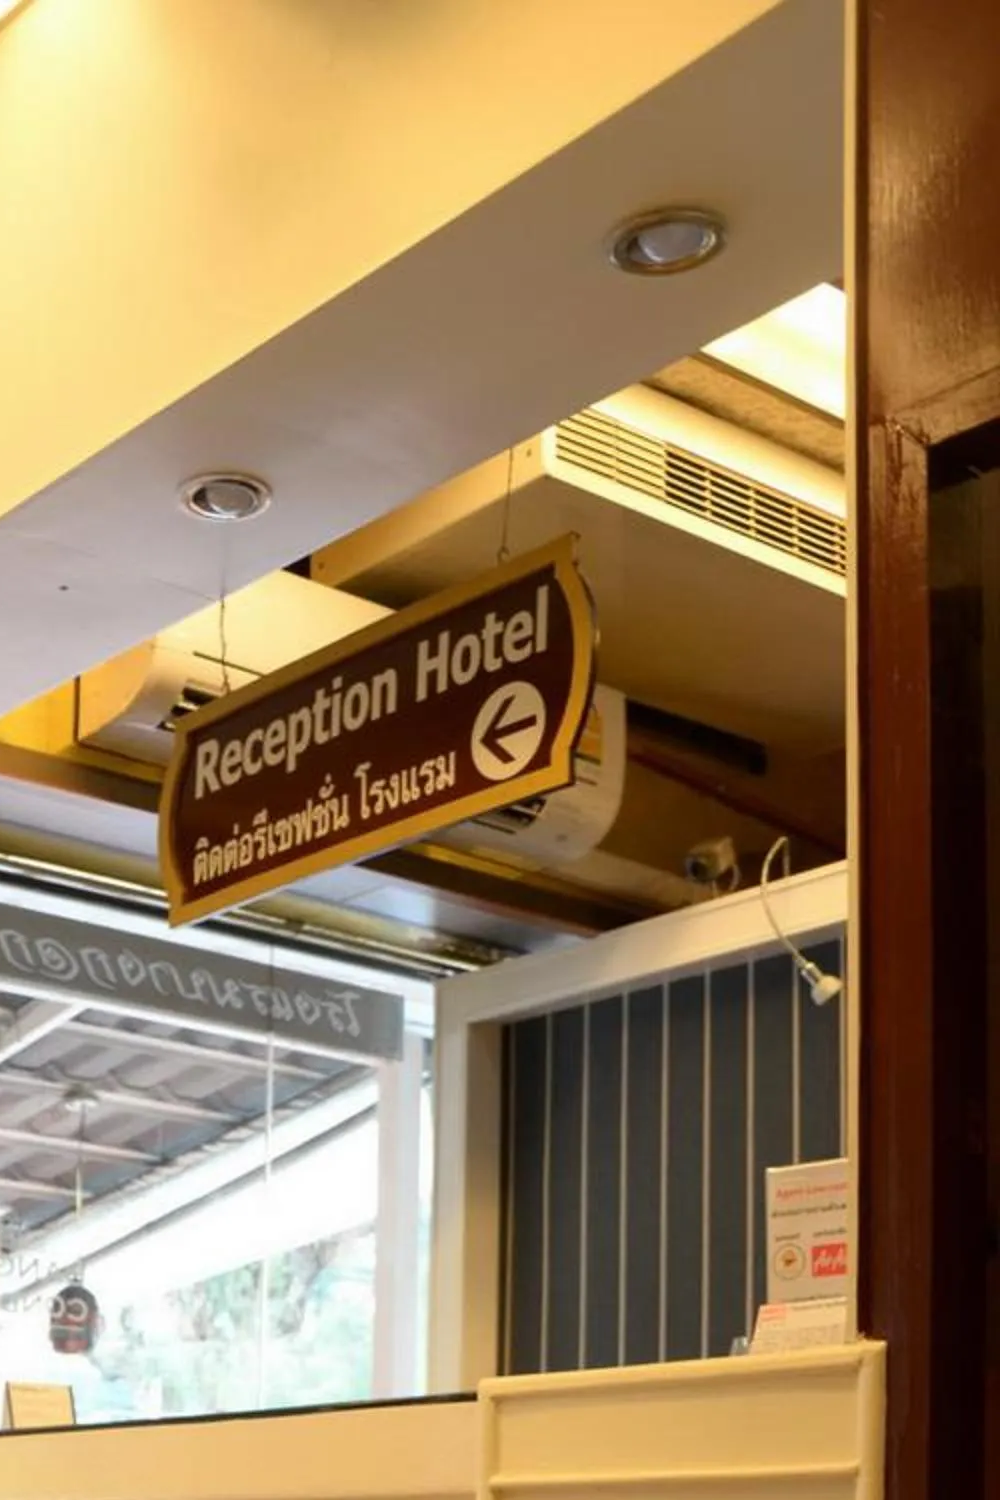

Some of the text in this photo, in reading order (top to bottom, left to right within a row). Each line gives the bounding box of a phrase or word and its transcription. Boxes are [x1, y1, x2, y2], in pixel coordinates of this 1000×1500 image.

[194, 586, 549, 800] Reception Hotel
[353, 751, 457, 819] โรงแรม
